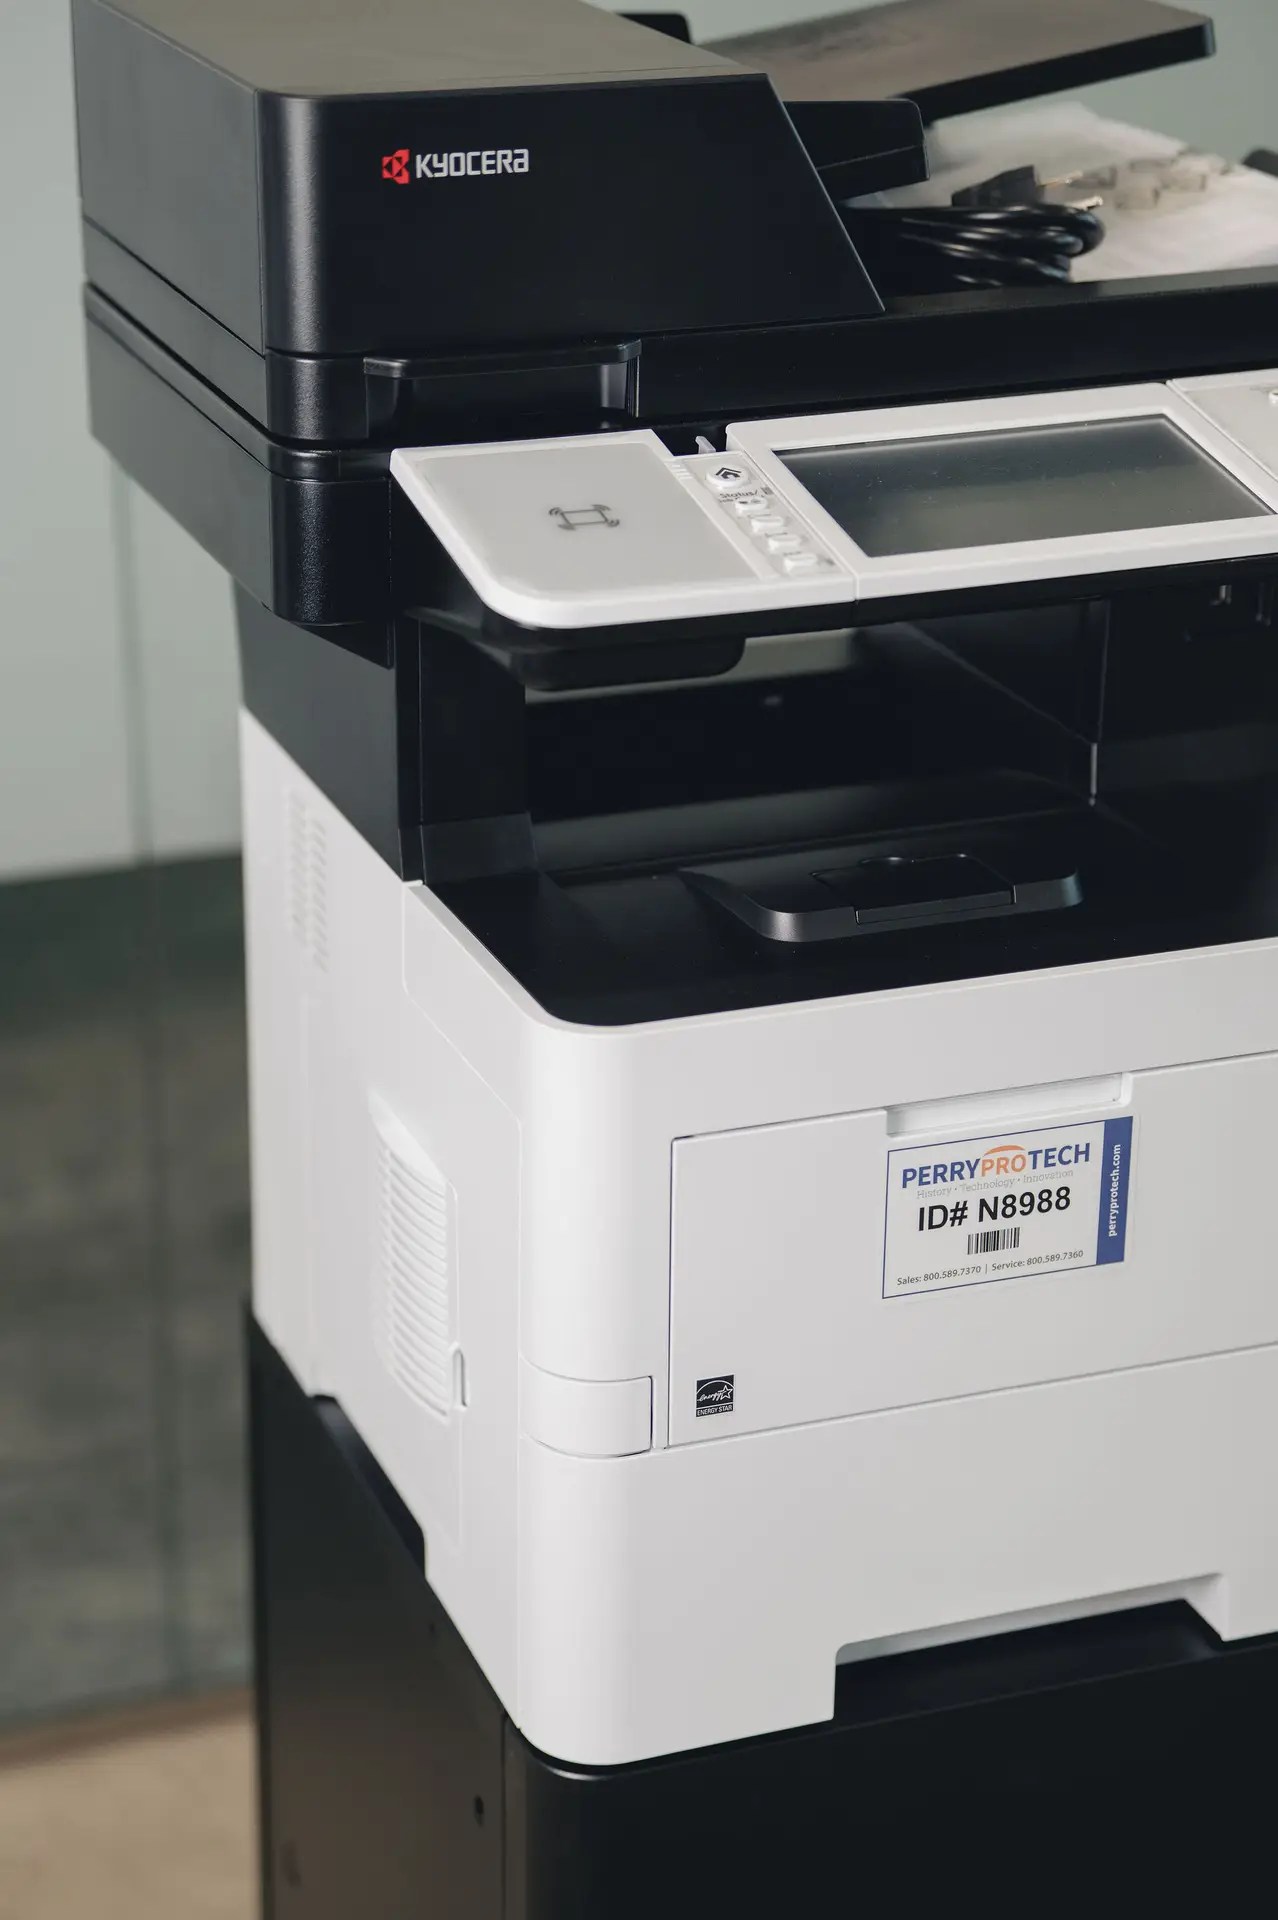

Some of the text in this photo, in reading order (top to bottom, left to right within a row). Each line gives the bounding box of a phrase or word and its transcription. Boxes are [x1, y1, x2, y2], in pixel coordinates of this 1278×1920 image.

[416, 149, 529, 178] KYOCERA
[917, 1169, 1074, 1199] History Technology Innovation
[1109, 1144, 1121, 1237] perryprotech.com
[918, 1186, 1071, 1232] ID# N8988
[897, 1250, 1084, 1286] Sales: 800.589.7370 Service: 800.589.7360
[697, 1404, 732, 1416] ENERGY STAR
